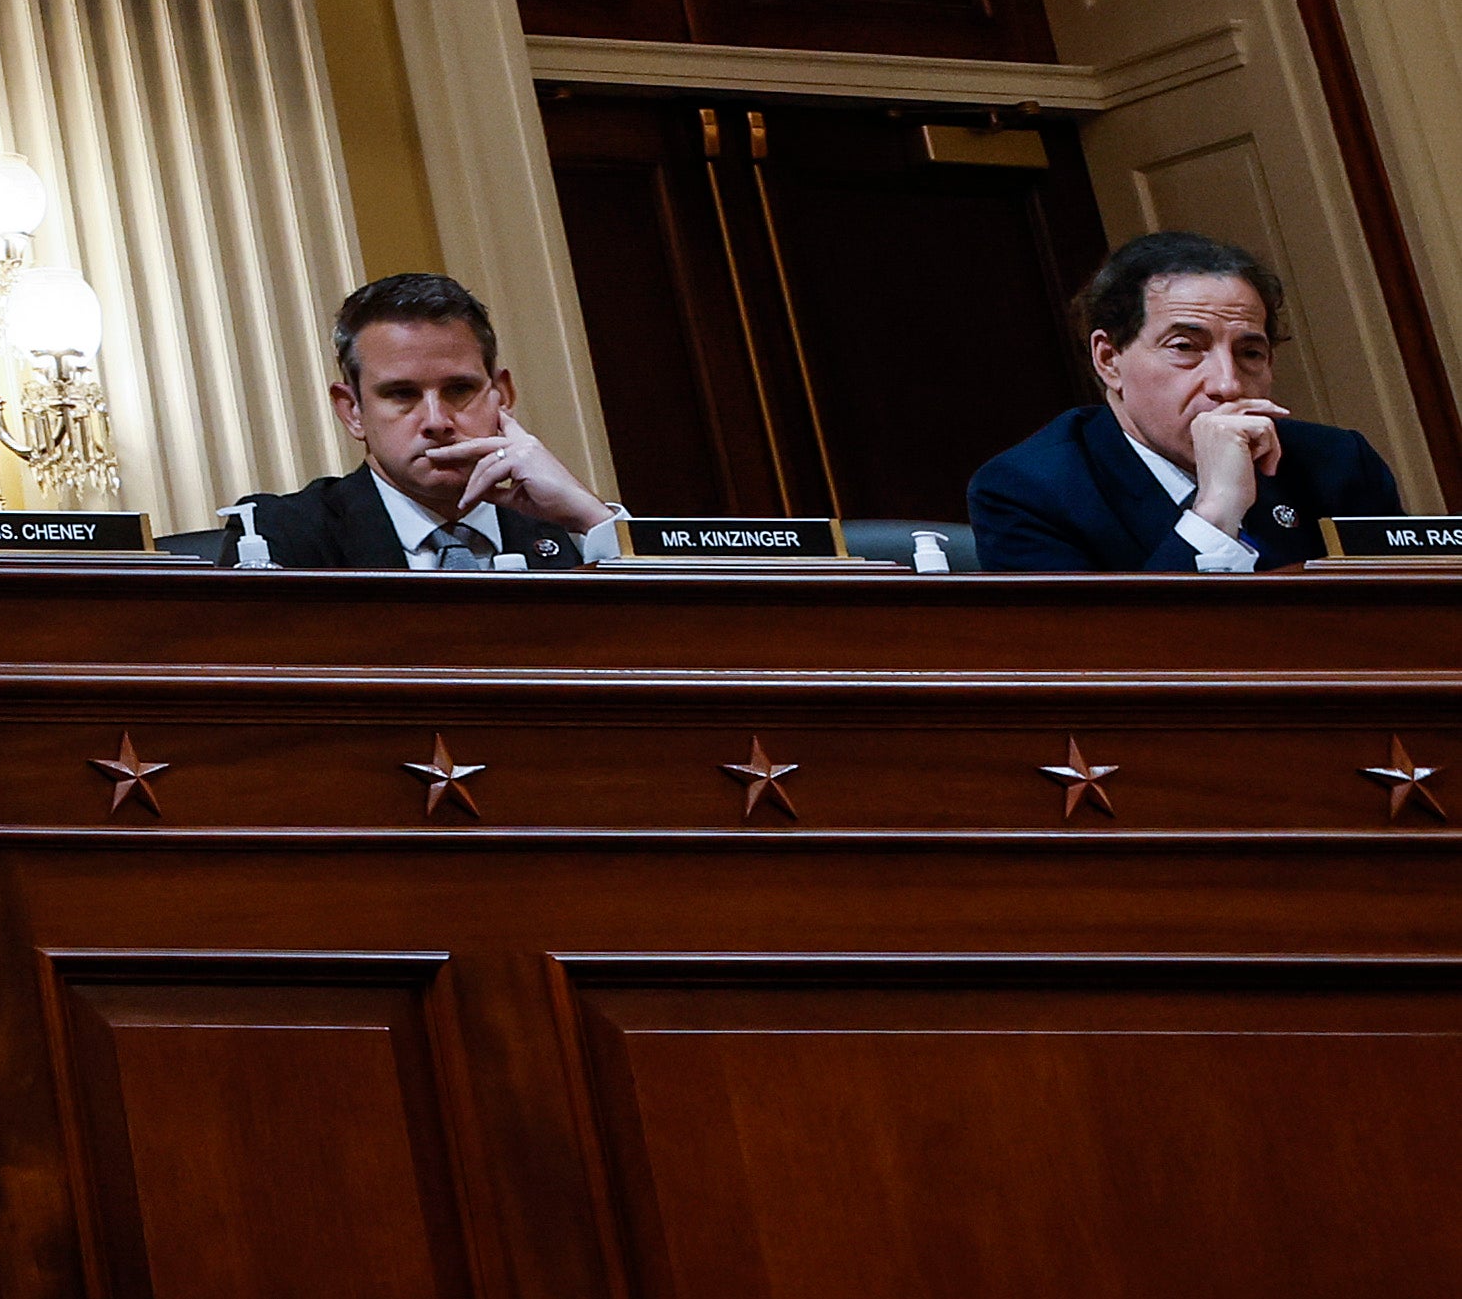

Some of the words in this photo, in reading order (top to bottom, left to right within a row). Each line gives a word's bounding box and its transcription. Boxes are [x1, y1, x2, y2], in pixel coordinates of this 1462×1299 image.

[21, 523, 96, 541] CHENEY
[661, 530, 697, 547] MR.
[699, 530, 801, 547] KINZINGER
[1385, 529, 1424, 547] MR.
